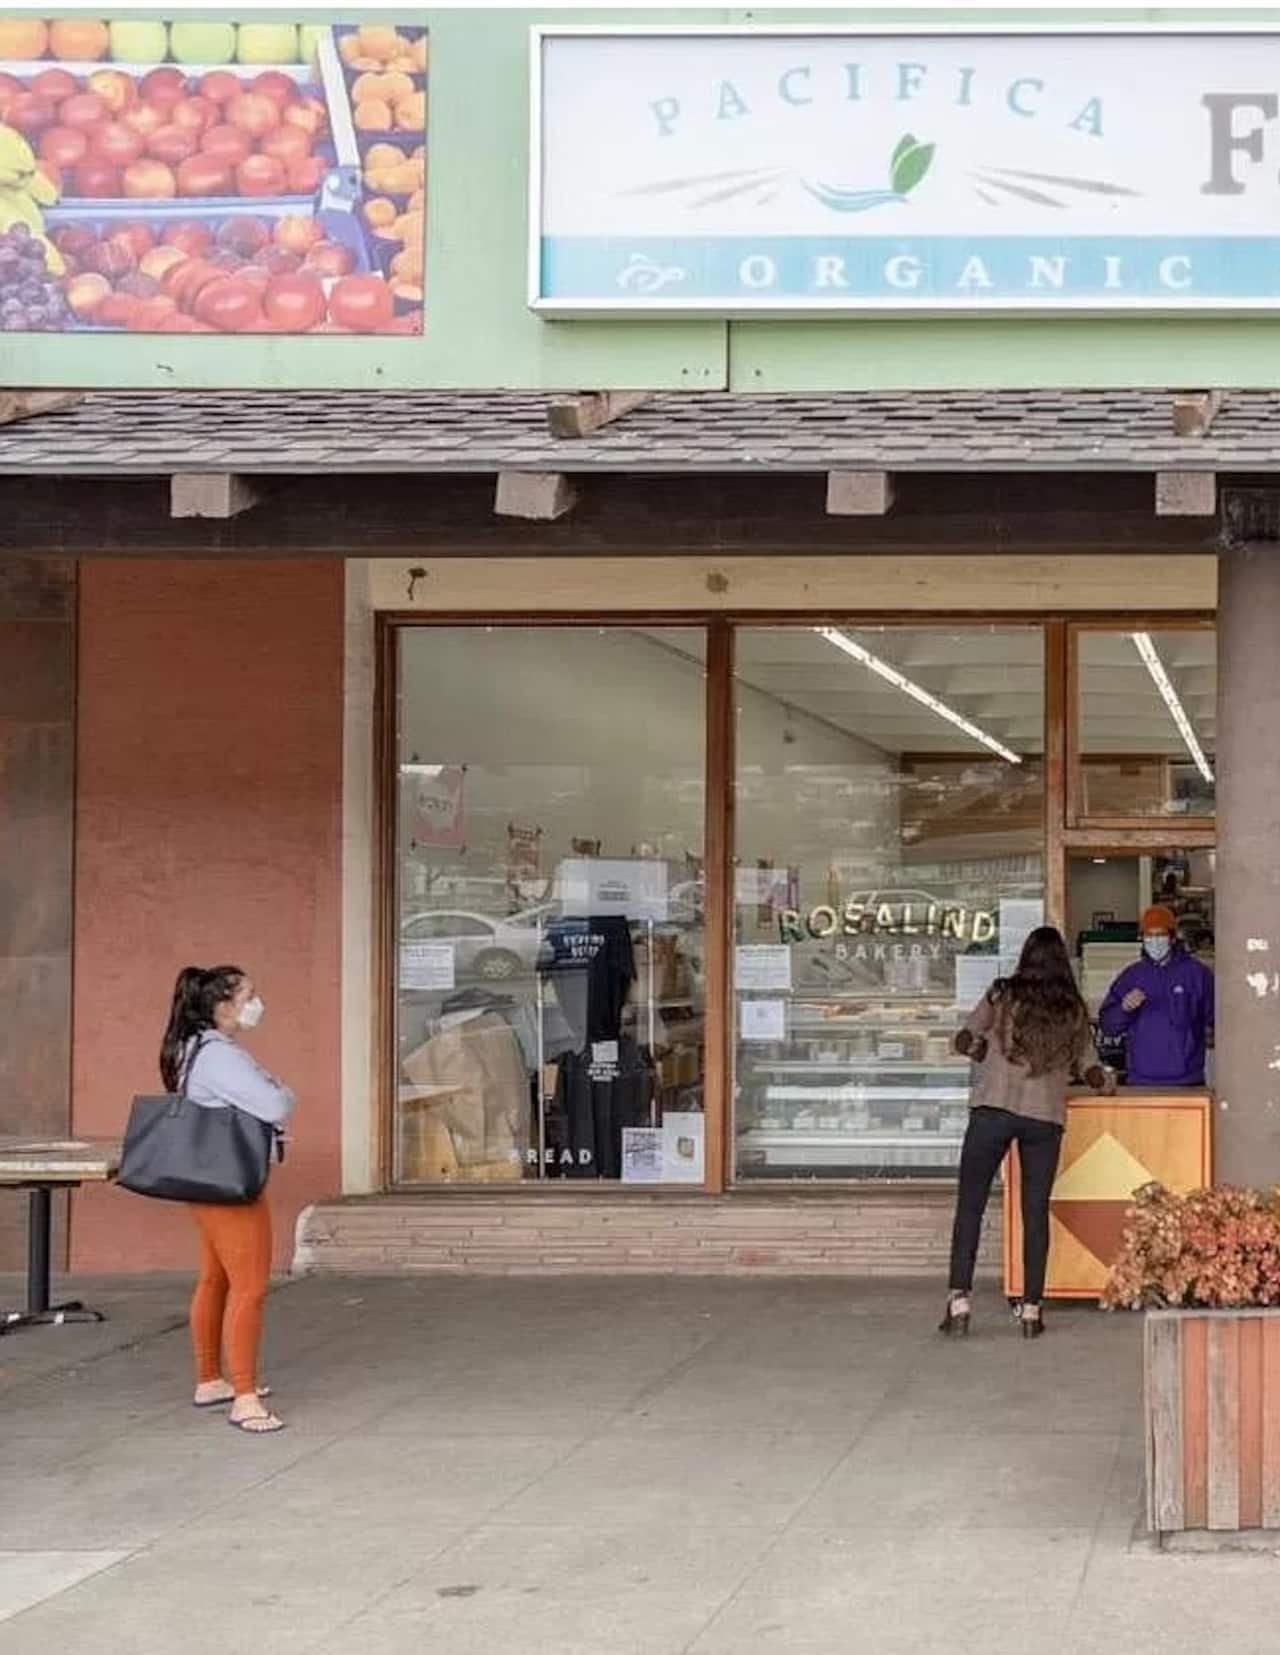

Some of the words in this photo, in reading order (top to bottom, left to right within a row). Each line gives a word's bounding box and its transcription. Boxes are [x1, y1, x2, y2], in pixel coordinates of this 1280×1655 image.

[652, 62, 1106, 137] PACIFICA
[739, 255, 1193, 290] ORGANIC
[779, 902, 997, 944] ROSALIND
[835, 943, 942, 961] BAKERY
